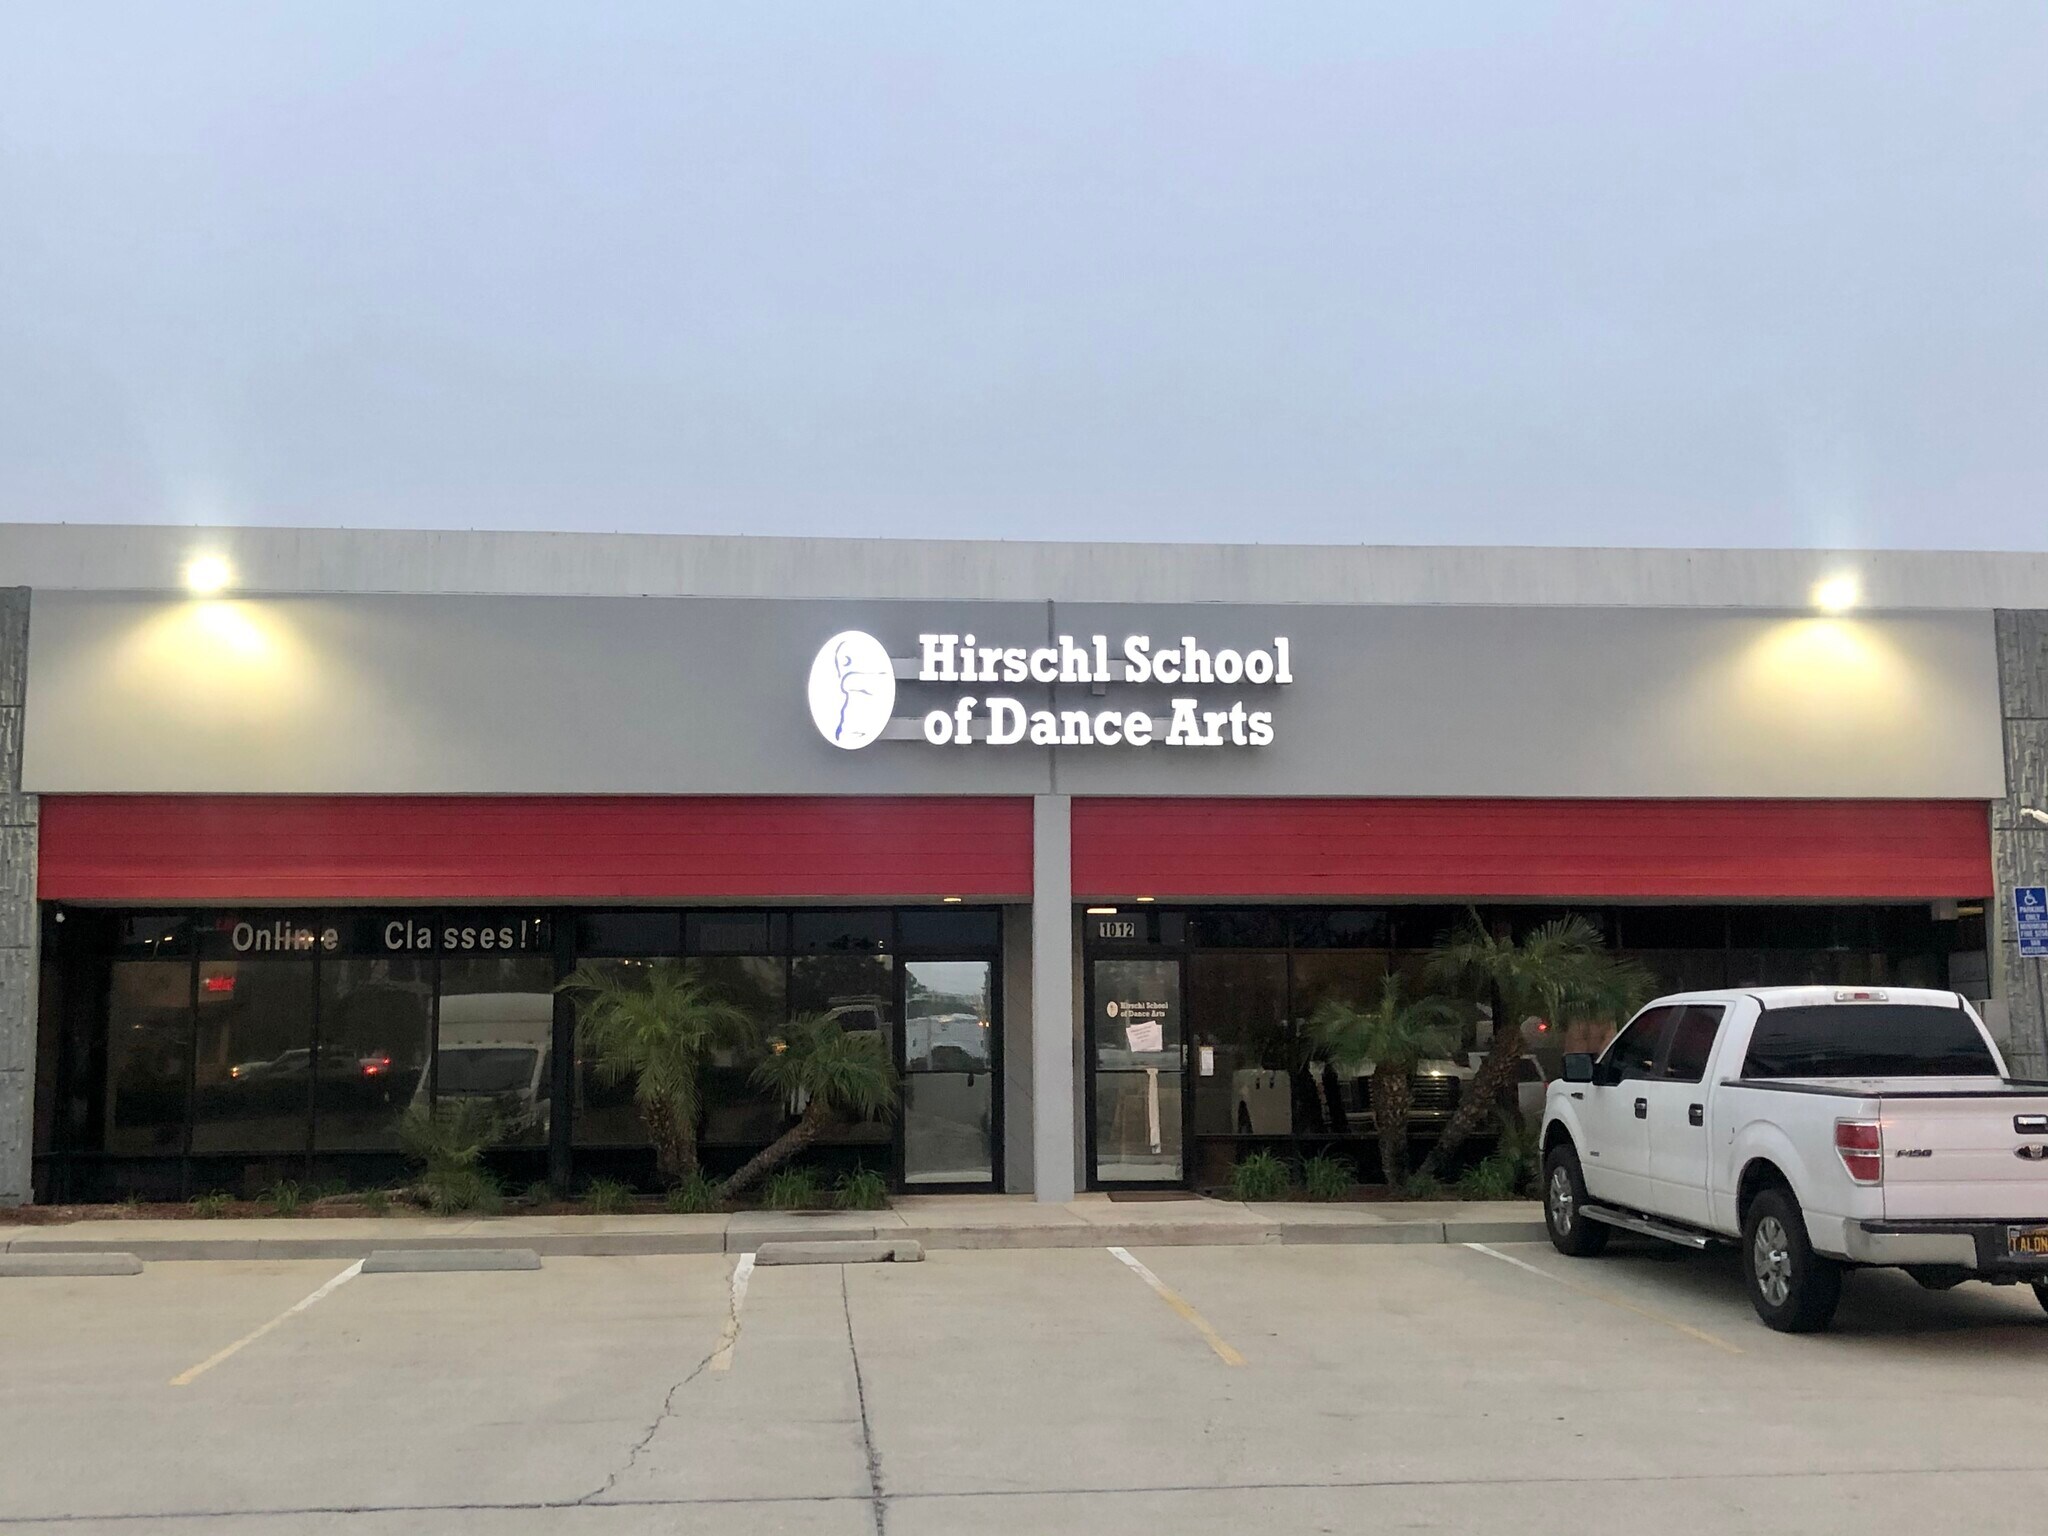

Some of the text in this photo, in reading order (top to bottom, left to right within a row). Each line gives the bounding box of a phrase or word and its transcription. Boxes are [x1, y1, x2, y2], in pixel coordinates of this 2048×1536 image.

[919, 634, 1293, 684] Hirschl School
[924, 696, 1274, 746] of Dance Arts
[232, 921, 339, 951] Online
[1102, 923, 1133, 937] 1012
[1129, 1010, 1150, 1018] Dance
